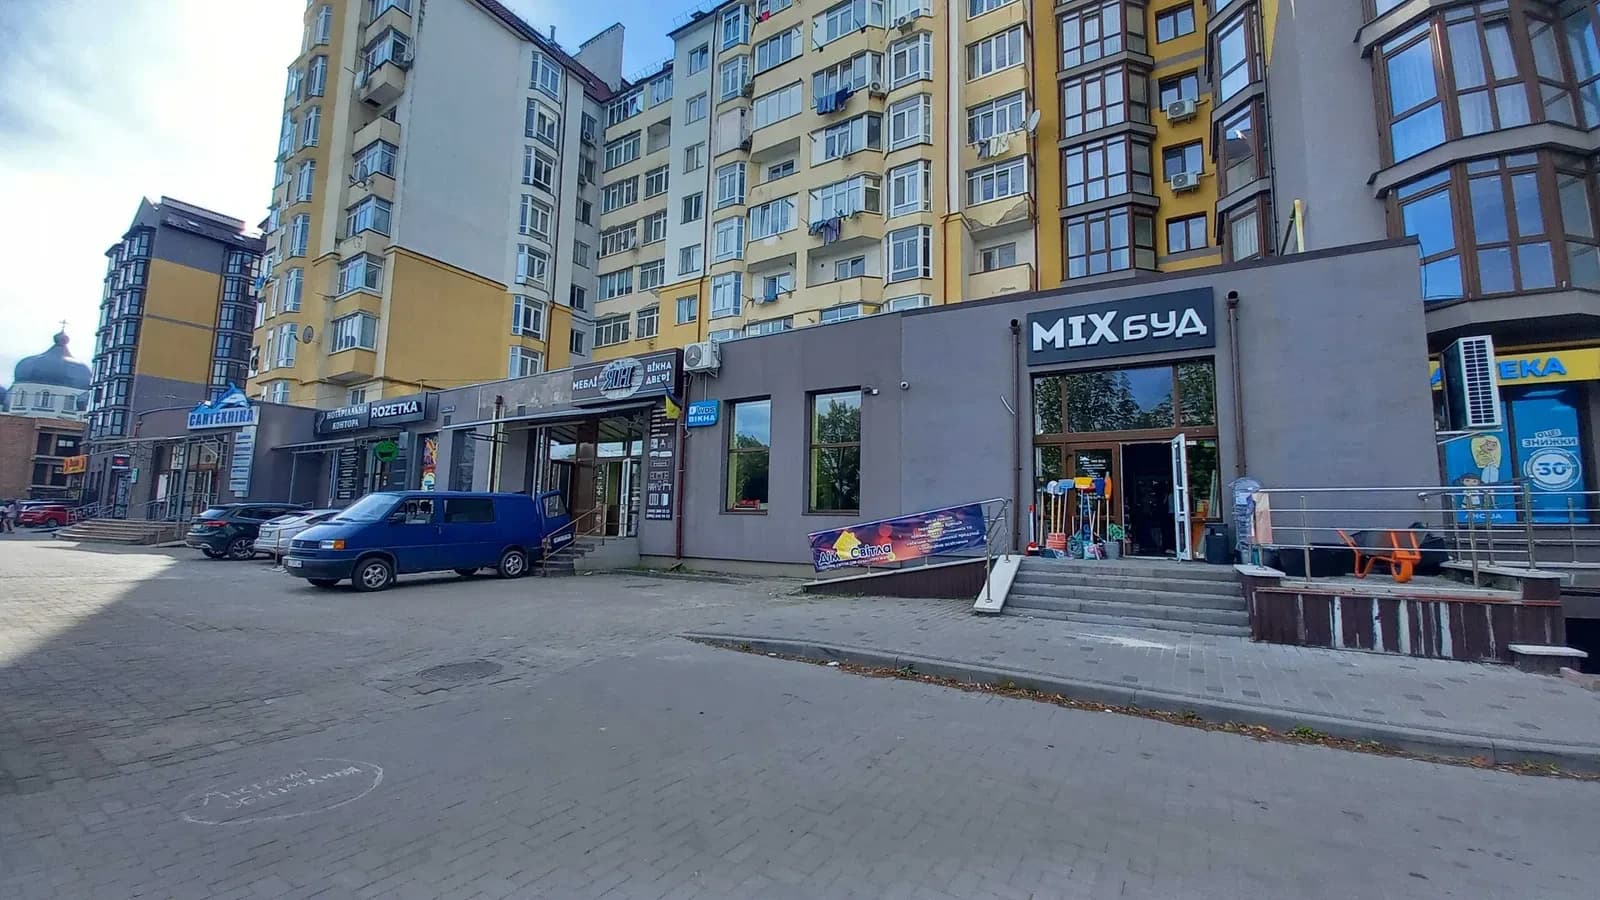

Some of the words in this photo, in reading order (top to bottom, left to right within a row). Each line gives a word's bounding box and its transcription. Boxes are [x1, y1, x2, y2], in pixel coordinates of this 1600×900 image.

[646, 361, 672, 373] ВІКНА
[572, 378, 598, 391] МЕБЛІ
[645, 374, 670, 385] ДВЕРІ
[371, 401, 418, 418] ROZETKA
[189, 409, 253, 426] САНТЕХНІКА
[688, 415, 716, 423] ВІКНА
[850, 544, 892, 559] Світла
